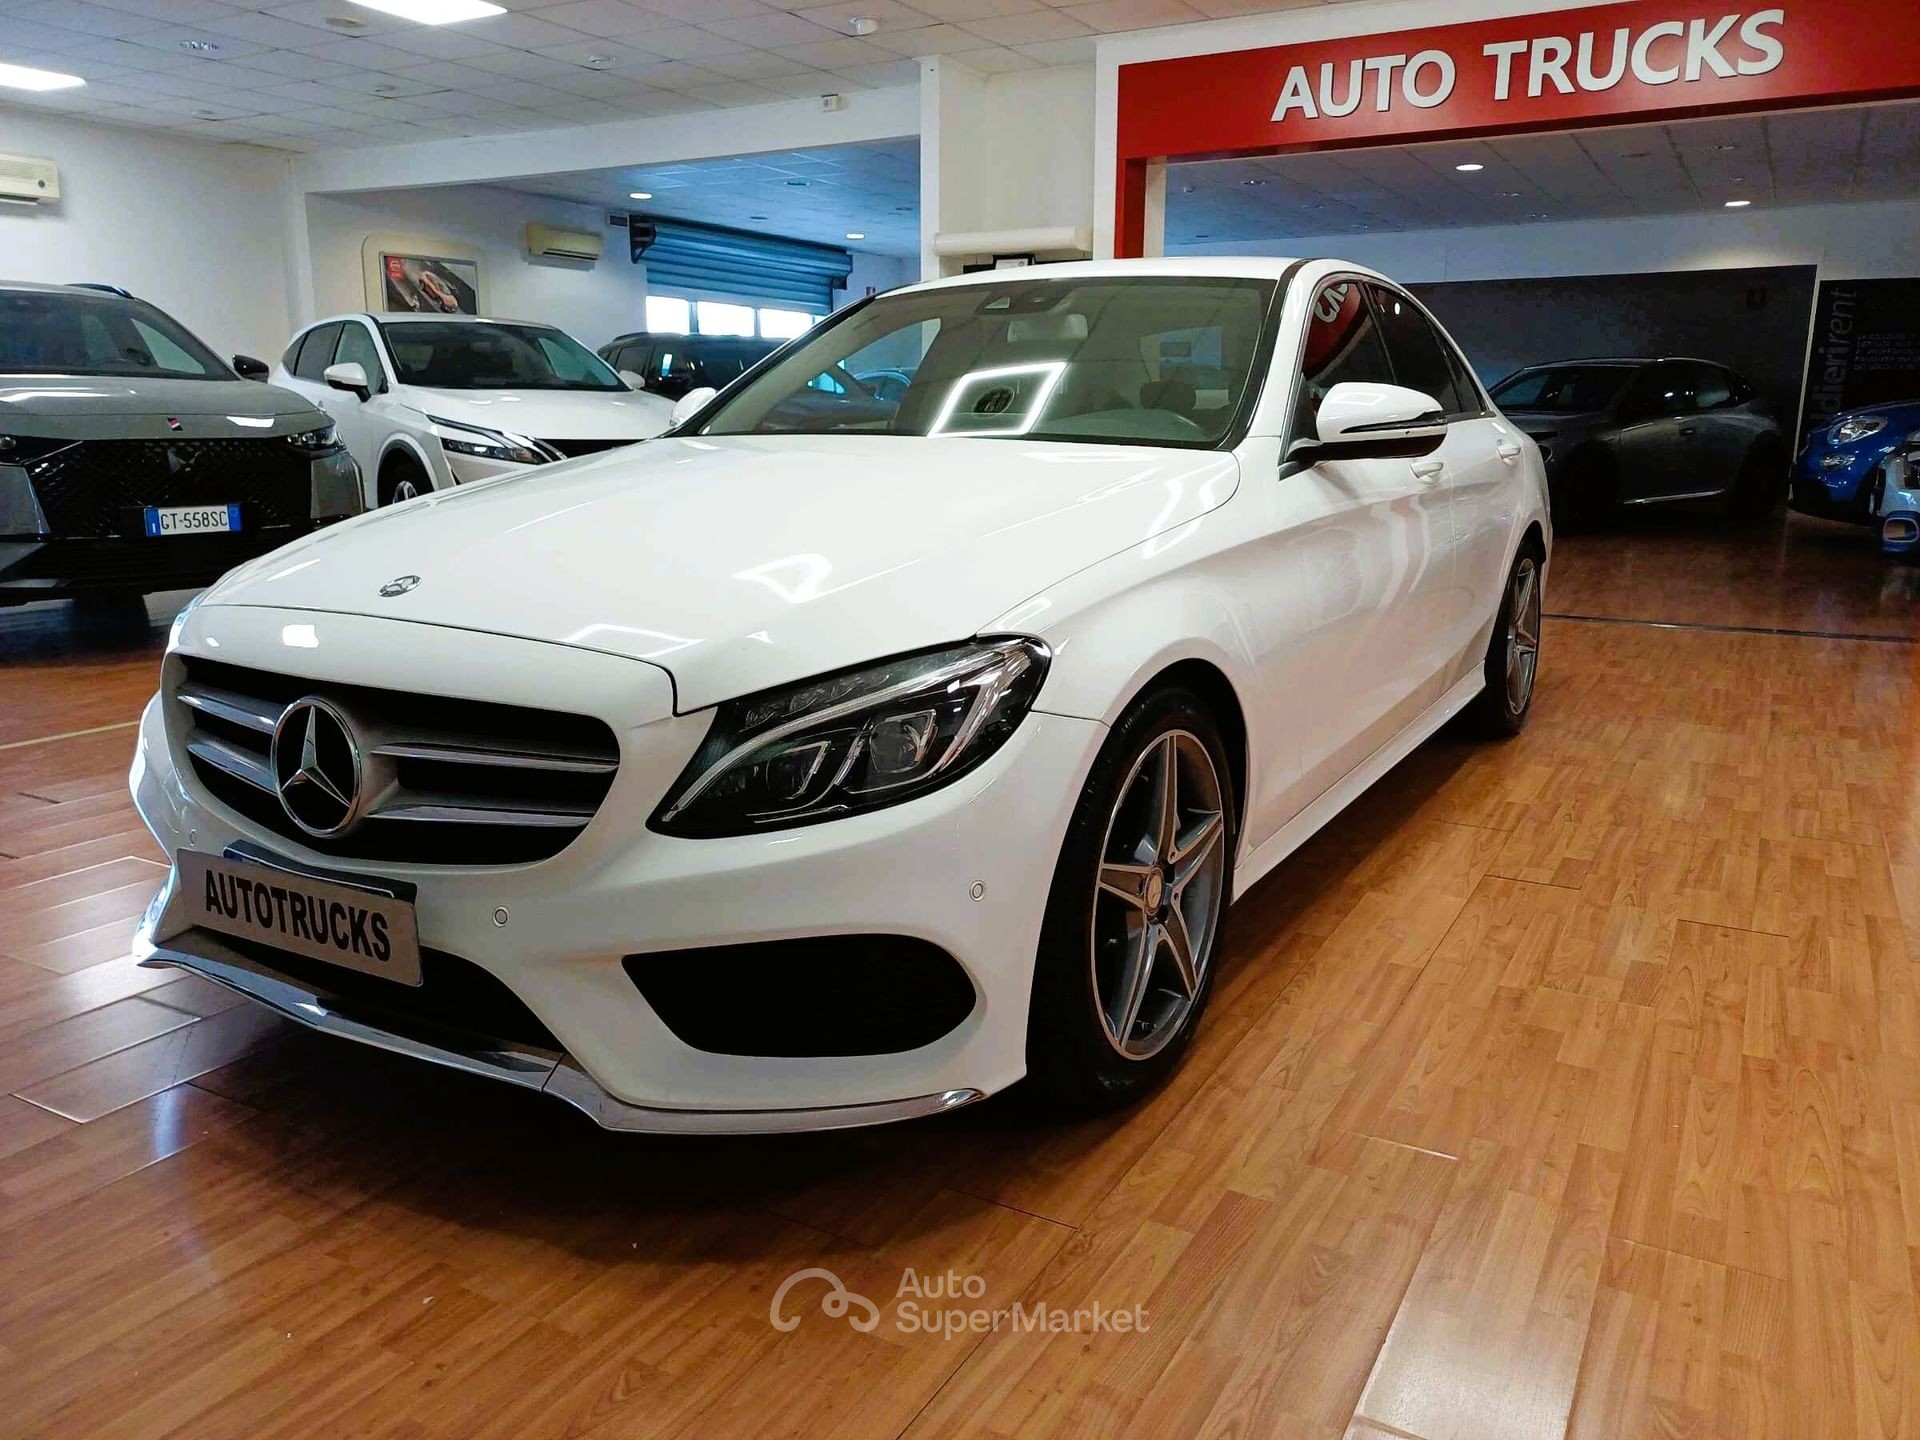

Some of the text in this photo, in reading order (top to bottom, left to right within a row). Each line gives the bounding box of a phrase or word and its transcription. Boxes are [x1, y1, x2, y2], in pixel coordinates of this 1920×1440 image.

[1269, 9, 1786, 123] AUTO TRUCKS
[205, 869, 391, 962] AUTOTRUCKS
